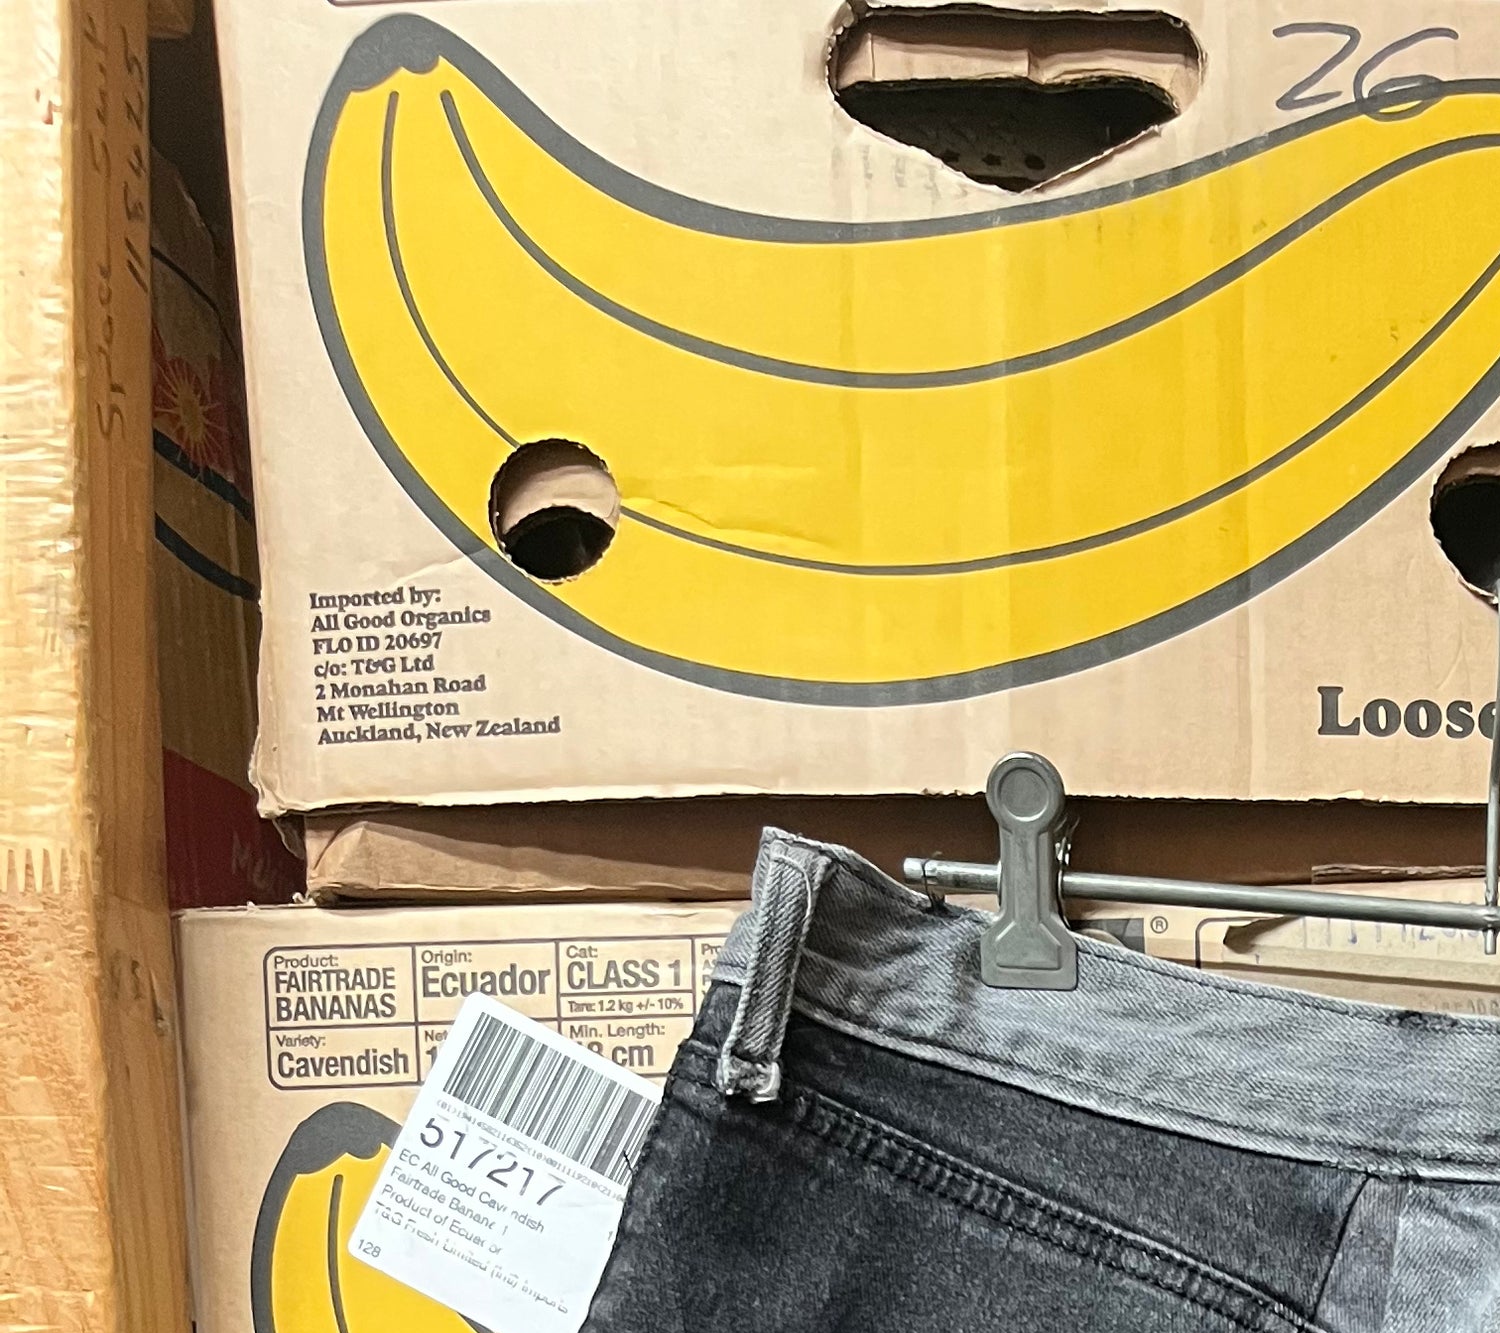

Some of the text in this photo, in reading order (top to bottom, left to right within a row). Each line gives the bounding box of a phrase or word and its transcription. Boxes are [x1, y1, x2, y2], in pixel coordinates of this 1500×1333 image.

[1272, 21, 1459, 122] 26
[310, 586, 441, 612] Imported by:
[311, 606, 492, 632] All Good Organics
[313, 631, 443, 655] FLO ID 20697
[314, 654, 434, 678] c/o: T&G Ltd
[315, 674, 486, 700] 2 Monahan Road
[317, 701, 459, 722] Mt Wellington
[318, 715, 561, 745] Auckland, New Zealand
[274, 945, 598, 969] Product: Origin: Cat:
[275, 967, 396, 994] FAIRTRADE
[422, 963, 551, 998] Ecuador
[567, 959, 660, 990] CLASS
[667, 959, 681, 986] 1
[276, 993, 396, 1022] BANANAS
[616, 999, 634, 1013] kg
[658, 998, 684, 1010] 10%
[276, 1034, 326, 1050] Variety:
[569, 1024, 603, 1038] Min.
[608, 1023, 665, 1038] Length:
[278, 1048, 409, 1079] Cavendish
[611, 1044, 655, 1067] cm
[399, 1149, 420, 1166] EC
[420, 1161, 438, 1177] All
[440, 1170, 476, 1198] Good
[420, 1117, 566, 1205] 517217
[391, 1166, 446, 1203] Fairtrade
[381, 1184, 448, 1228] Product of
[357, 1238, 382, 1258] 128
